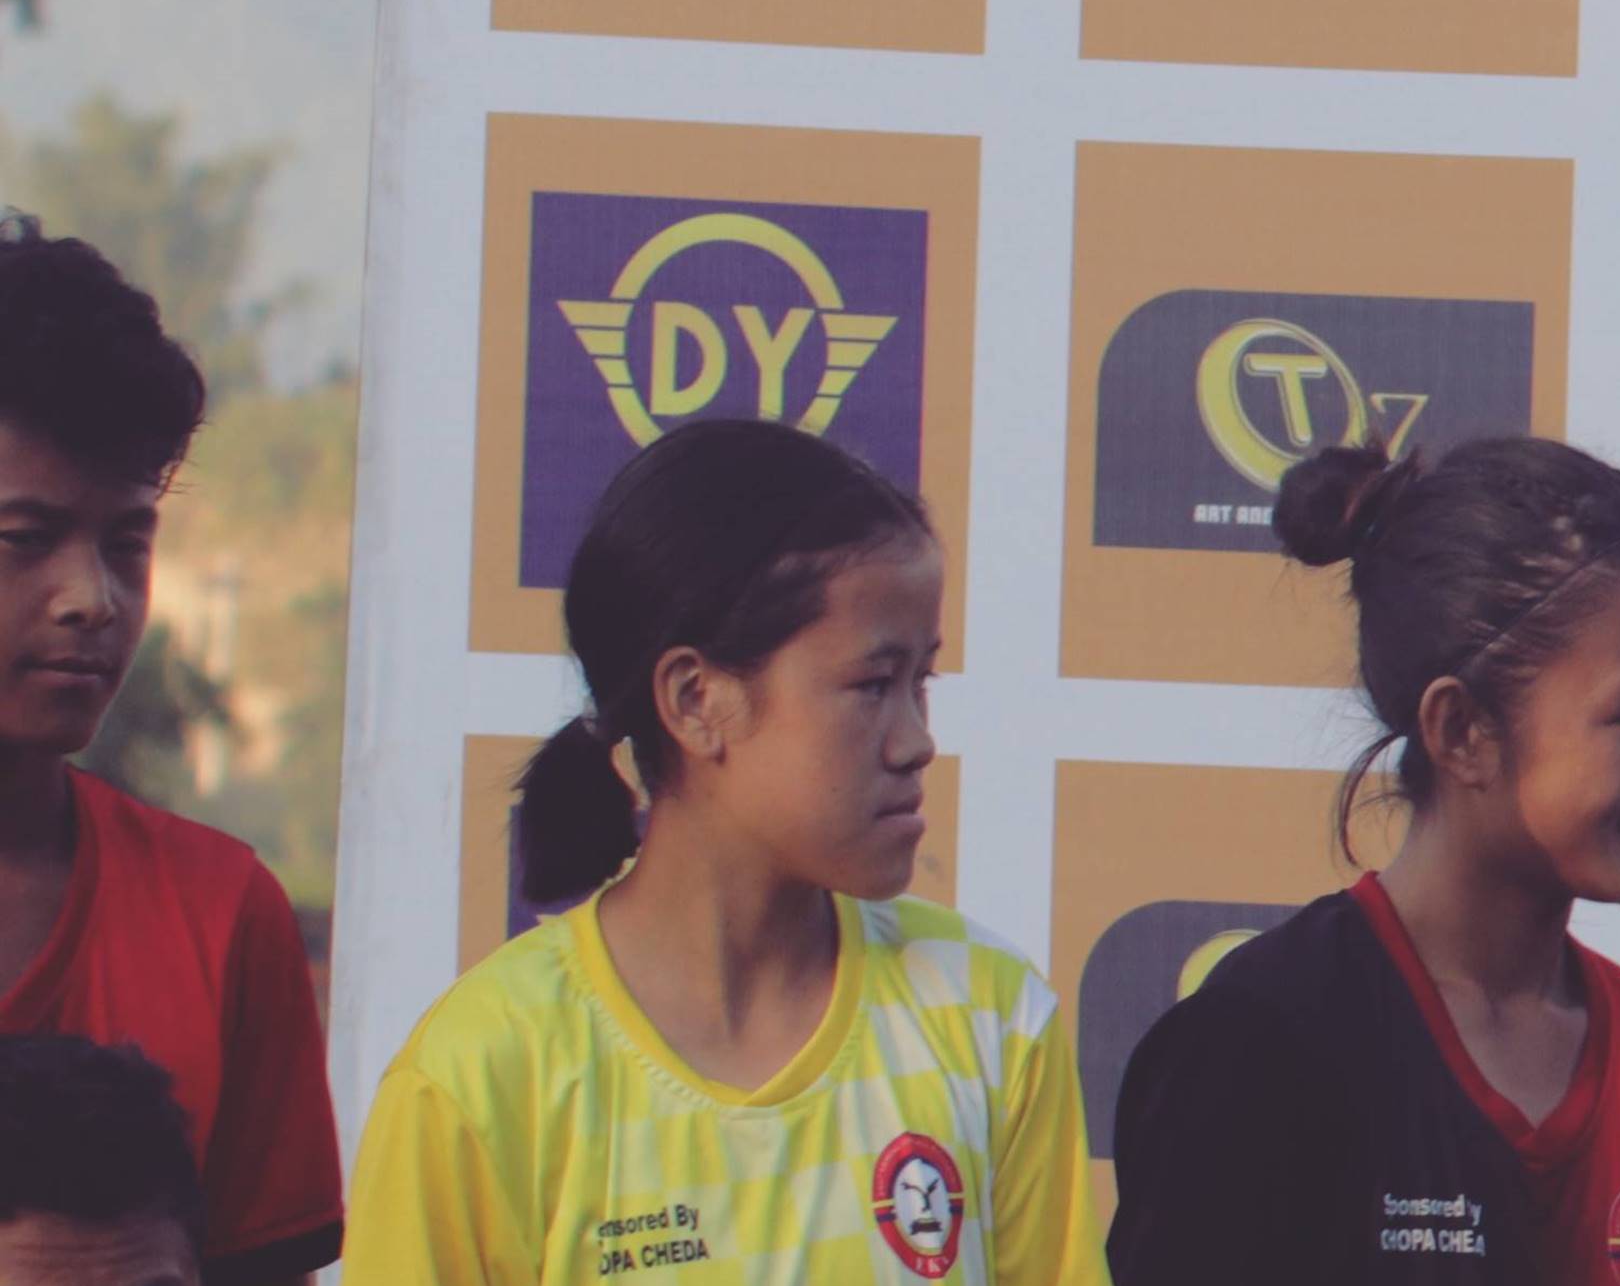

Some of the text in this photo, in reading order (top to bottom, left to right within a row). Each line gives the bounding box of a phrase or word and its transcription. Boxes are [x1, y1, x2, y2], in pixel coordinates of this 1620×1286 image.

[649, 301, 815, 423] DY
[674, 1204, 699, 1231] By
[641, 1239, 711, 1267] CHEDA
